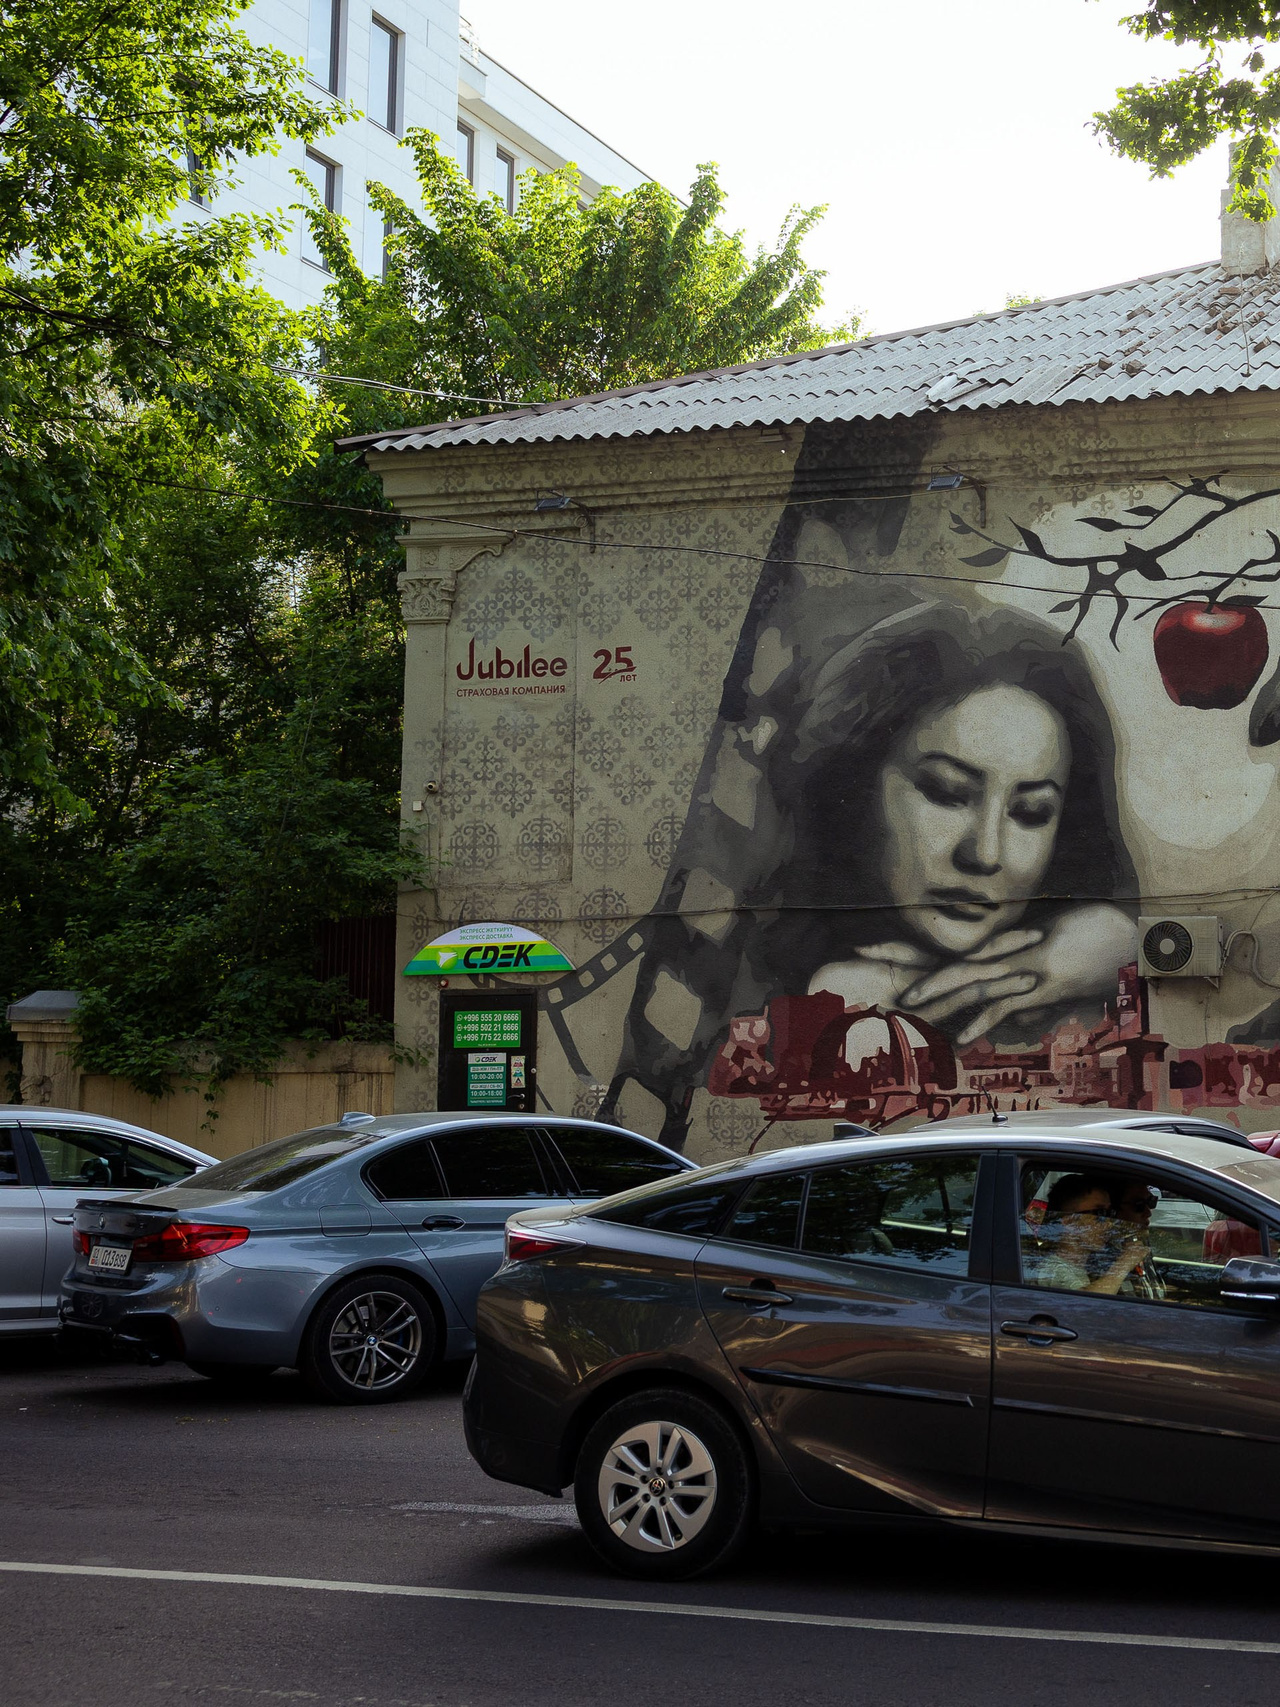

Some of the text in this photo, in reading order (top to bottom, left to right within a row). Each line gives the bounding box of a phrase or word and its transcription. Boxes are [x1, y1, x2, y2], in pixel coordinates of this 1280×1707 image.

[456, 637, 568, 680] Jubilee
[592, 646, 636, 681] 25
[619, 674, 637, 683] лет
[456, 685, 566, 698] СТРАХОВАЯ КОМПАНИЯ
[463, 944, 536, 969] CDEK
[463, 1013, 519, 1022] +996 555 20 6666
[463, 1023, 519, 1032] +996 502 21 6666
[480, 1033, 492, 1041] 775
[493, 1033, 501, 1041] 22
[502, 1033, 519, 1041] 6666
